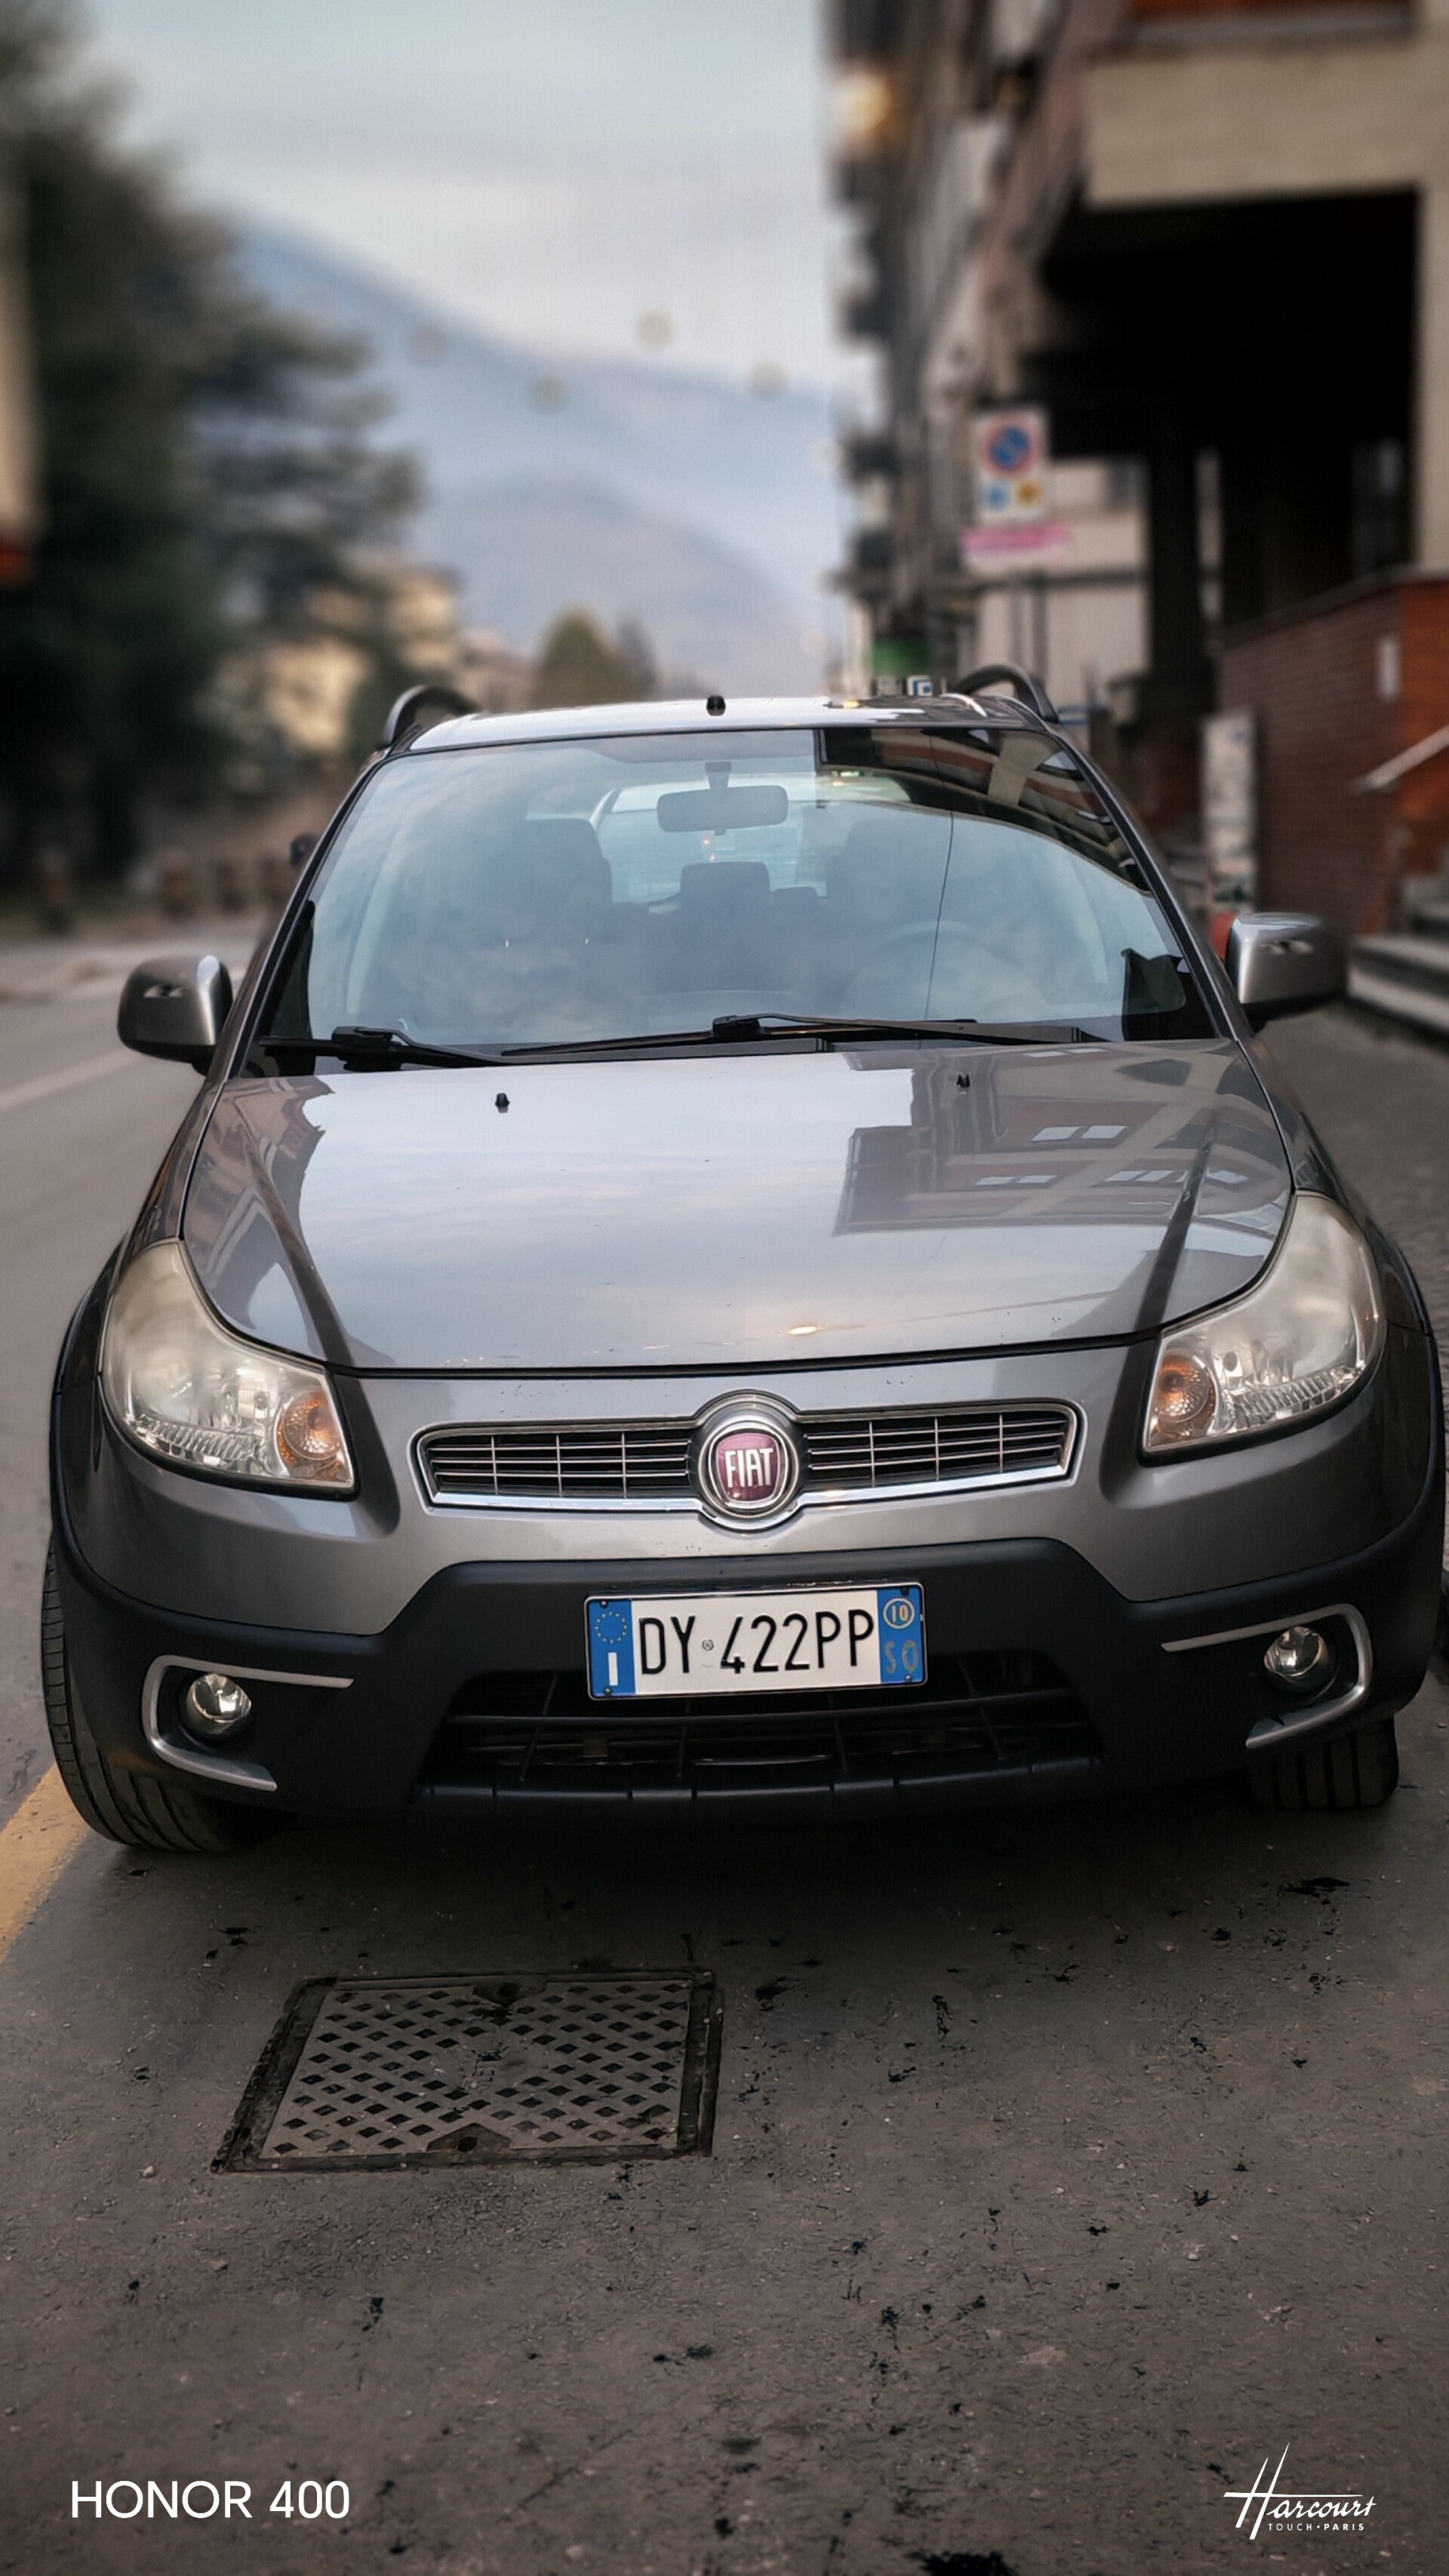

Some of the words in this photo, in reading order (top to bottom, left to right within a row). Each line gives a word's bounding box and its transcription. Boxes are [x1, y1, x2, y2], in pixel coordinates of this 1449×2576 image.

[724, 1448, 774, 1488] FIAT
[891, 1604, 910, 1623] 10
[638, 1615, 696, 1675] DY
[720, 1609, 875, 1674] 422PP
[884, 1640, 919, 1673] SO
